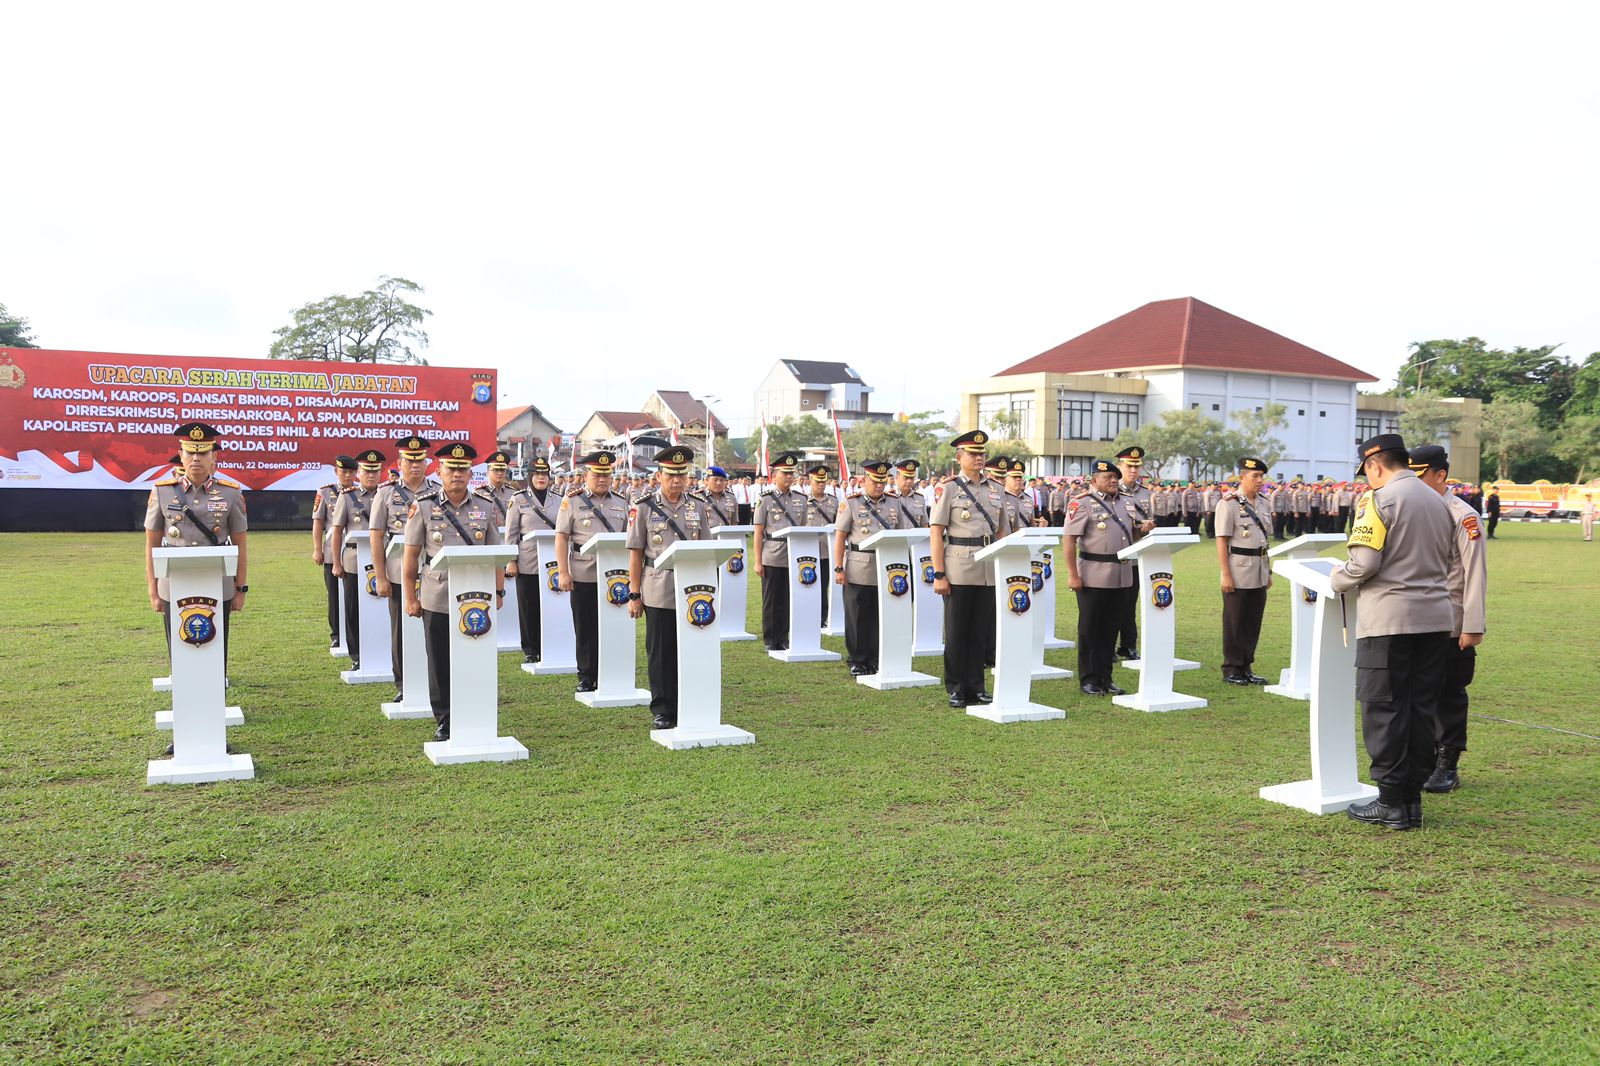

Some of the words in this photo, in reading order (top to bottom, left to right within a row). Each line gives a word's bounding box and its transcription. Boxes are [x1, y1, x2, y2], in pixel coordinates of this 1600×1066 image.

[89, 365, 186, 386] UPACARA
[188, 368, 253, 388] SERAH
[256, 371, 330, 391] TERIMA
[332, 374, 416, 394] JABATAN
[33, 387, 108, 402] KAROSDM,
[110, 390, 180, 405] KAROOPS,
[182, 392, 236, 405] DANSAT
[238, 394, 293, 408] BRIMOB,
[295, 396, 378, 411] DIRSAMAPTA,
[380, 398, 459, 412] DIRINTELKAM
[65, 404, 178, 421] DIRRESKRIMSUS,
[181, 408, 295, 424] DIRRESNARKOBA,
[297, 411, 315, 422] KA
[317, 411, 345, 425] SPN,
[347, 412, 436, 428] KABIDDOKKES,
[23, 419, 115, 433] KAPOLRESTA
[213, 424, 274, 437] APOLRES
[276, 426, 309, 438] INHIL
[312, 427, 321, 438] &
[323, 427, 387, 440] KAPOLRES
[418, 429, 470, 441] MERANTI
[221, 440, 265, 452] POLDA
[268, 441, 298, 452] RIAU
[258, 461, 300, 470] Desember
[301, 461, 321, 470] 2023
